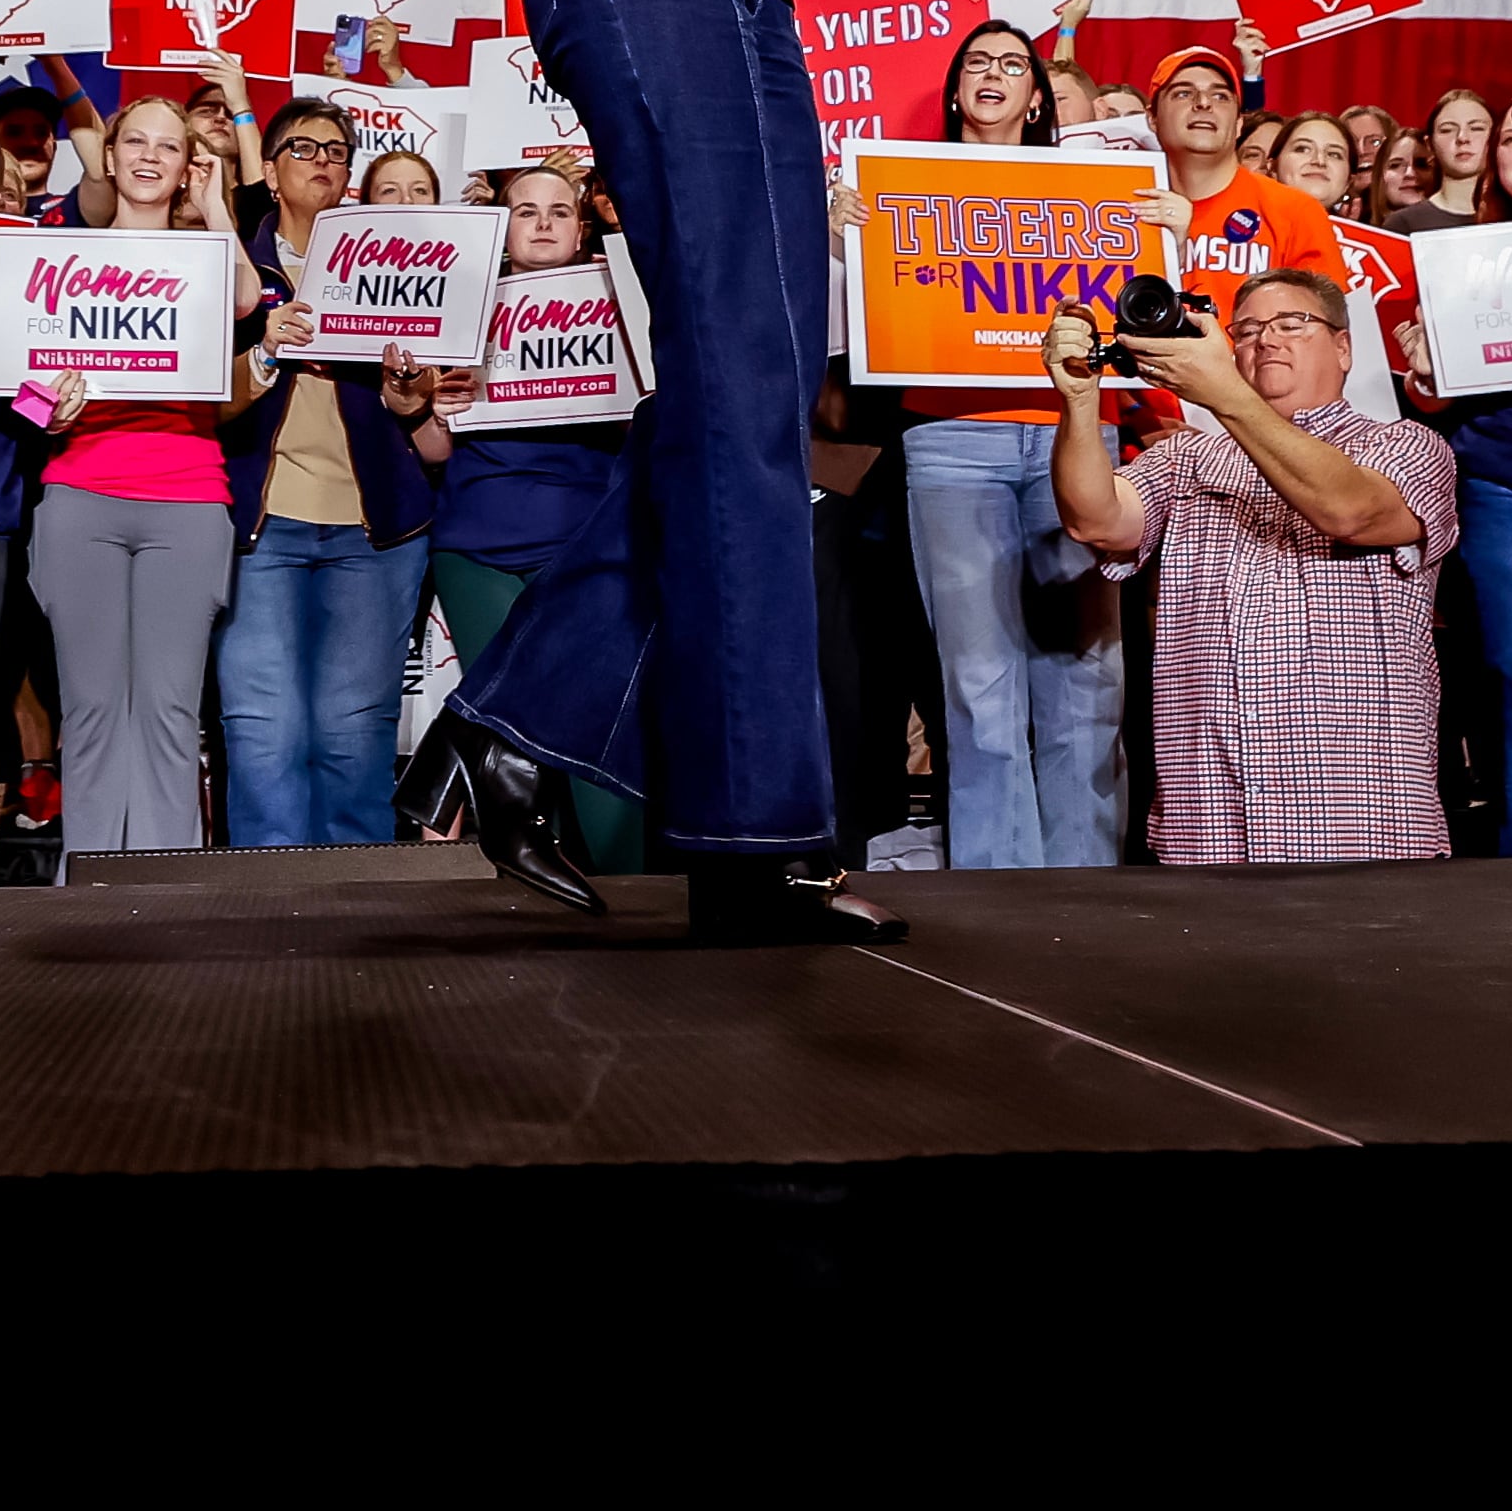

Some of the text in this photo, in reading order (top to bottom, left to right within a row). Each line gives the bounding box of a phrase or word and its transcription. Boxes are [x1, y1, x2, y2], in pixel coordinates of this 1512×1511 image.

[796, 0, 951, 54] LYWEDS
[809, 66, 874, 105] OR
[348, 106, 404, 131] PICK
[820, 115, 884, 157] KKI
[876, 193, 1140, 260] TIGERS
[327, 228, 459, 283] Women
[1181, 235, 1270, 275] MSON
[25, 254, 189, 315] Women
[322, 275, 446, 307] FOR NIKKI
[961, 261, 1135, 314] NIKK
[27, 306, 177, 340] FOR NIKKI
[326, 317, 435, 335] NikkiHaley.com
[488, 294, 620, 351] Women
[975, 330, 1047, 345] NIKKIHA
[1475, 312, 1512, 330] FOR
[36, 352, 172, 370] NikkiHaley.com
[485, 333, 614, 371] FOR NIKKI
[493, 381, 610, 398] NikkiHaley.com
